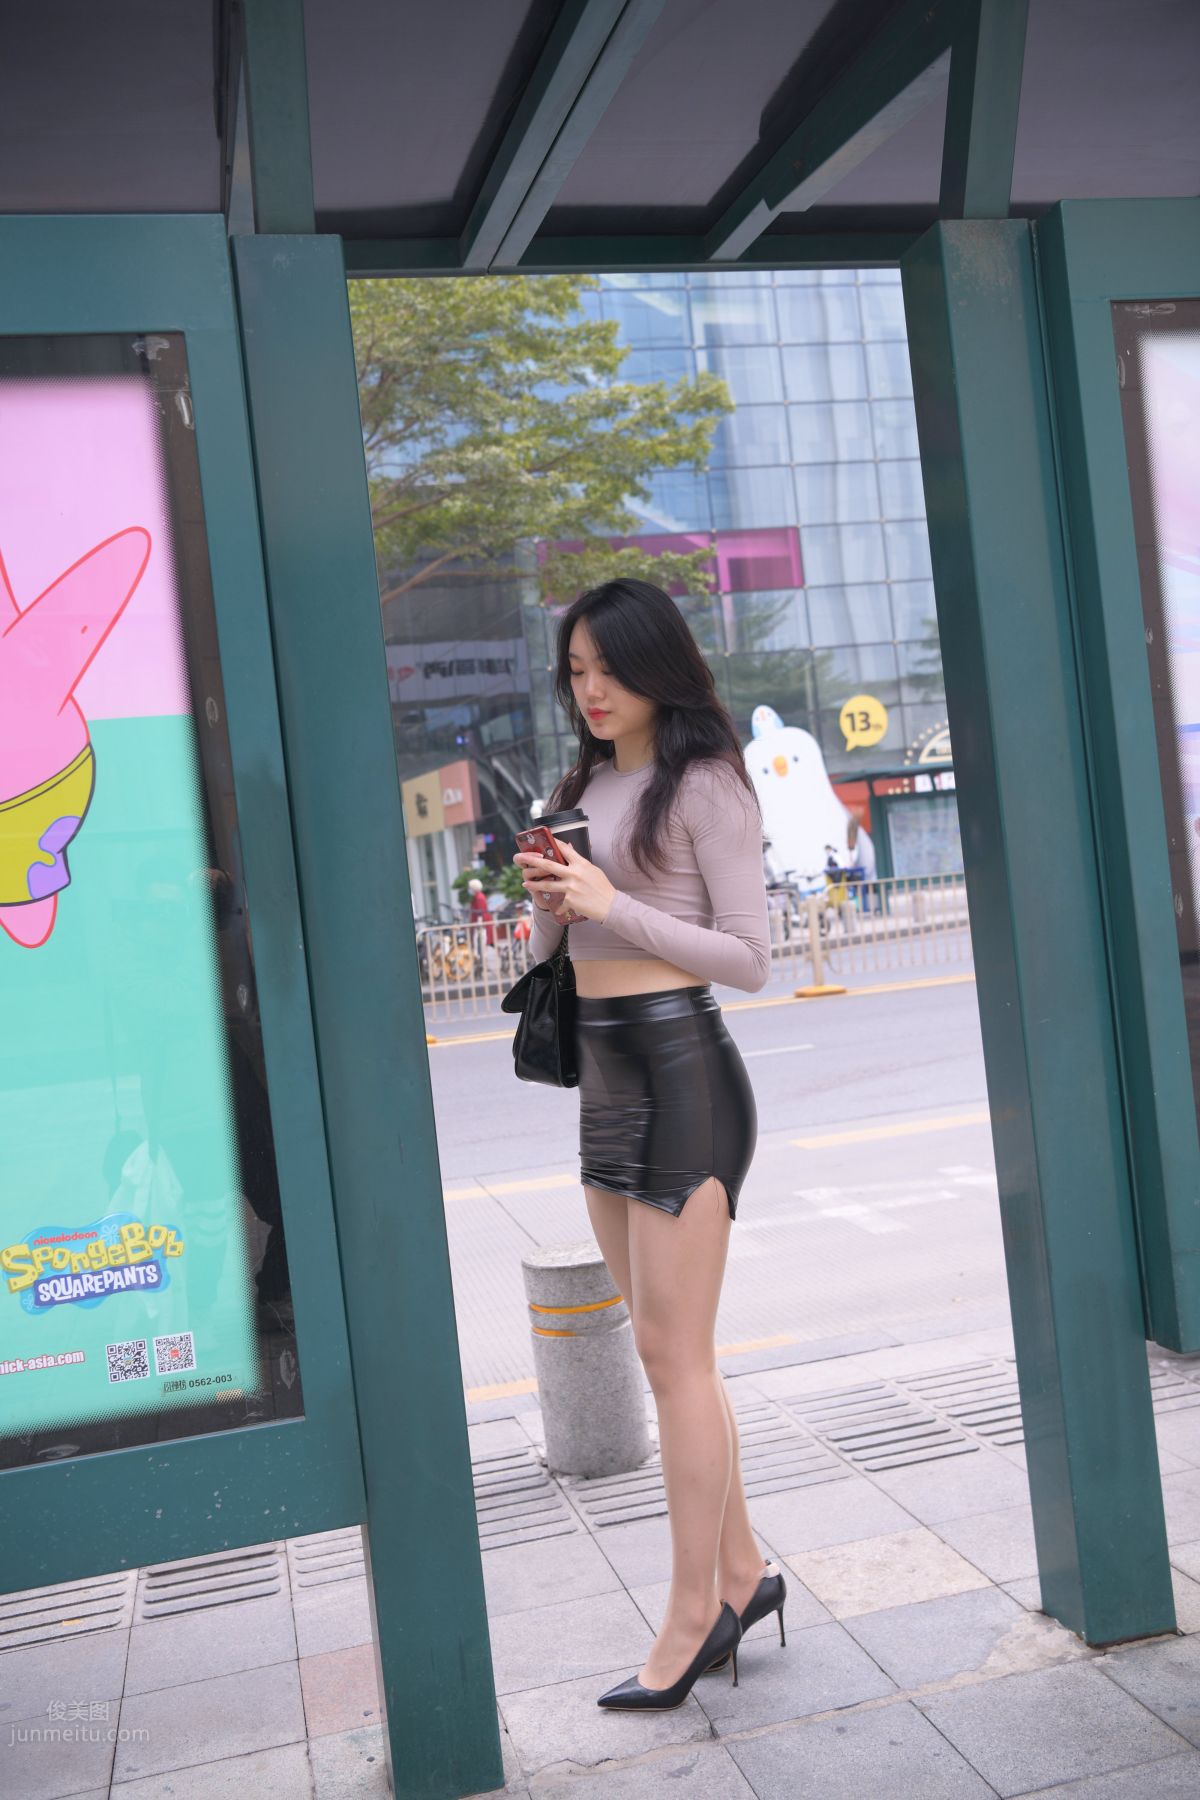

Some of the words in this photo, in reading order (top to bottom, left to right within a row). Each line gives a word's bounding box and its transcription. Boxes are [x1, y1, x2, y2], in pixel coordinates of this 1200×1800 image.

[845, 711, 871, 732] 13
[34, 1231, 98, 1247] nickelodeon
[38, 1265, 158, 1302] SQUAREPANTS
[188, 1374, 233, 1388] 0562-003
